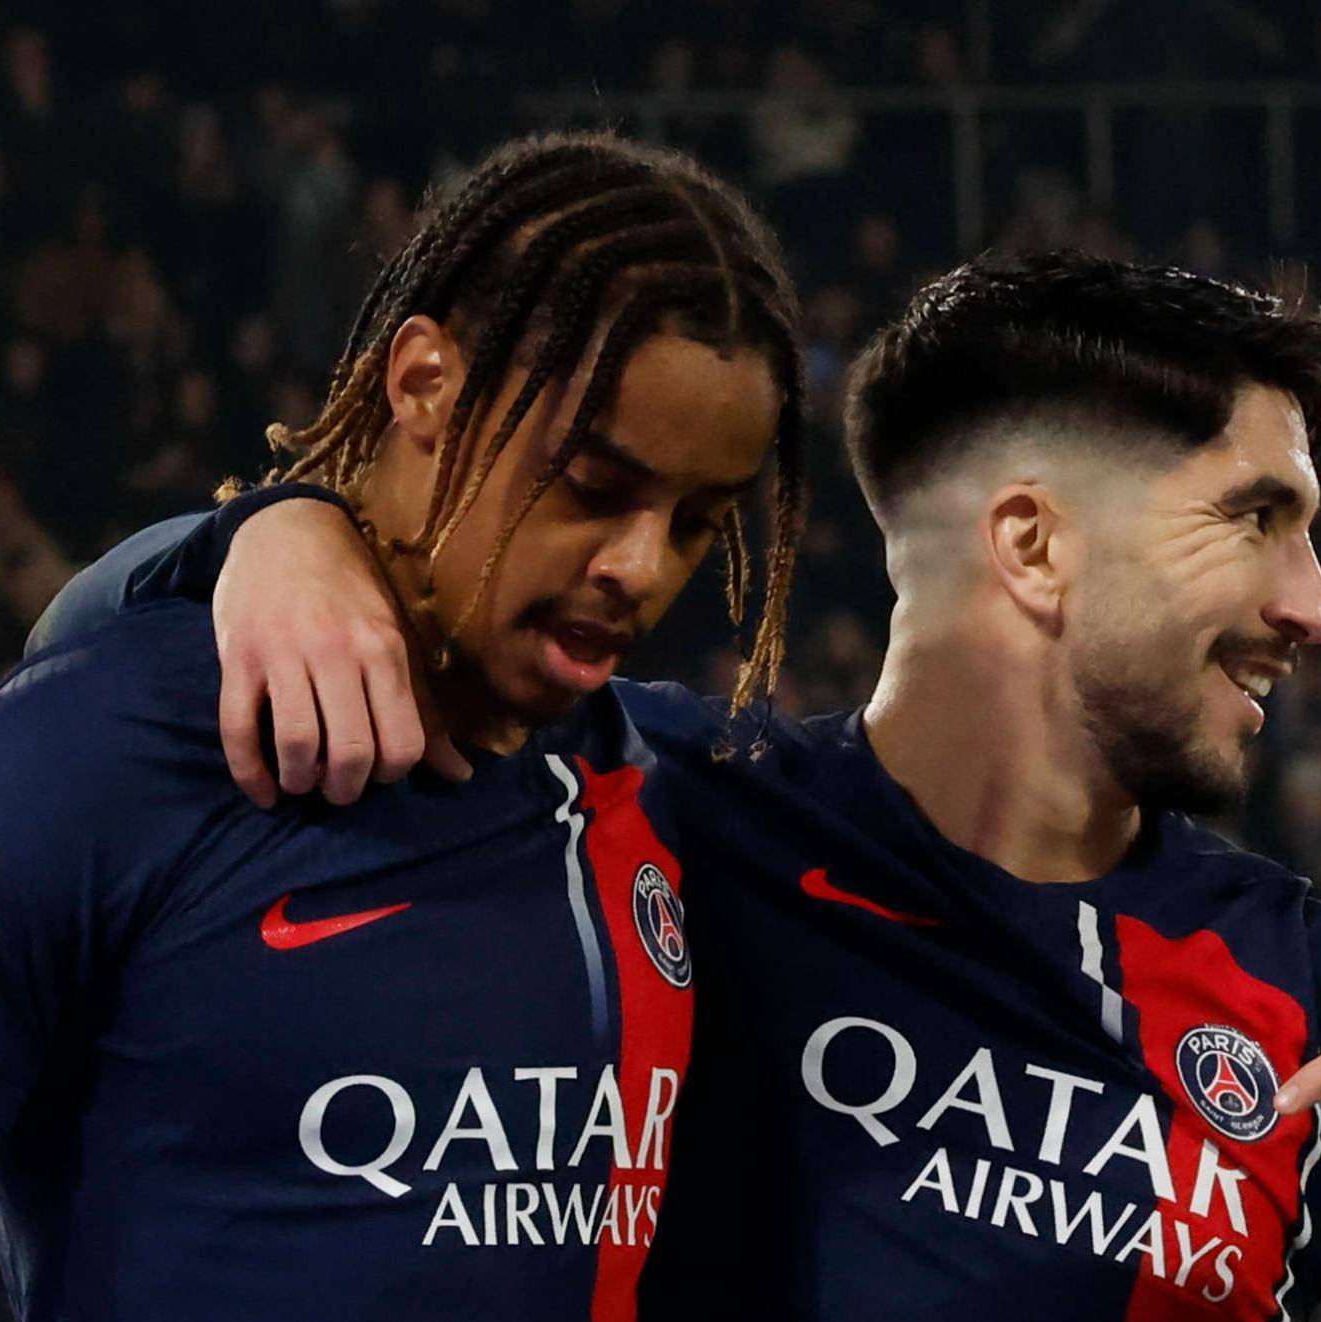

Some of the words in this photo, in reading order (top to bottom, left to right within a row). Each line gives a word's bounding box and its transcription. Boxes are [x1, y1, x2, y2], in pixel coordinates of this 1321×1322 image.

[1187, 1033, 1256, 1066] PARIS
[298, 1063, 679, 1199] QATAR
[800, 1016, 1250, 1239] QATAR
[421, 1181, 661, 1249] AIRWAYS
[901, 1147, 1243, 1303] AIRWAYS
